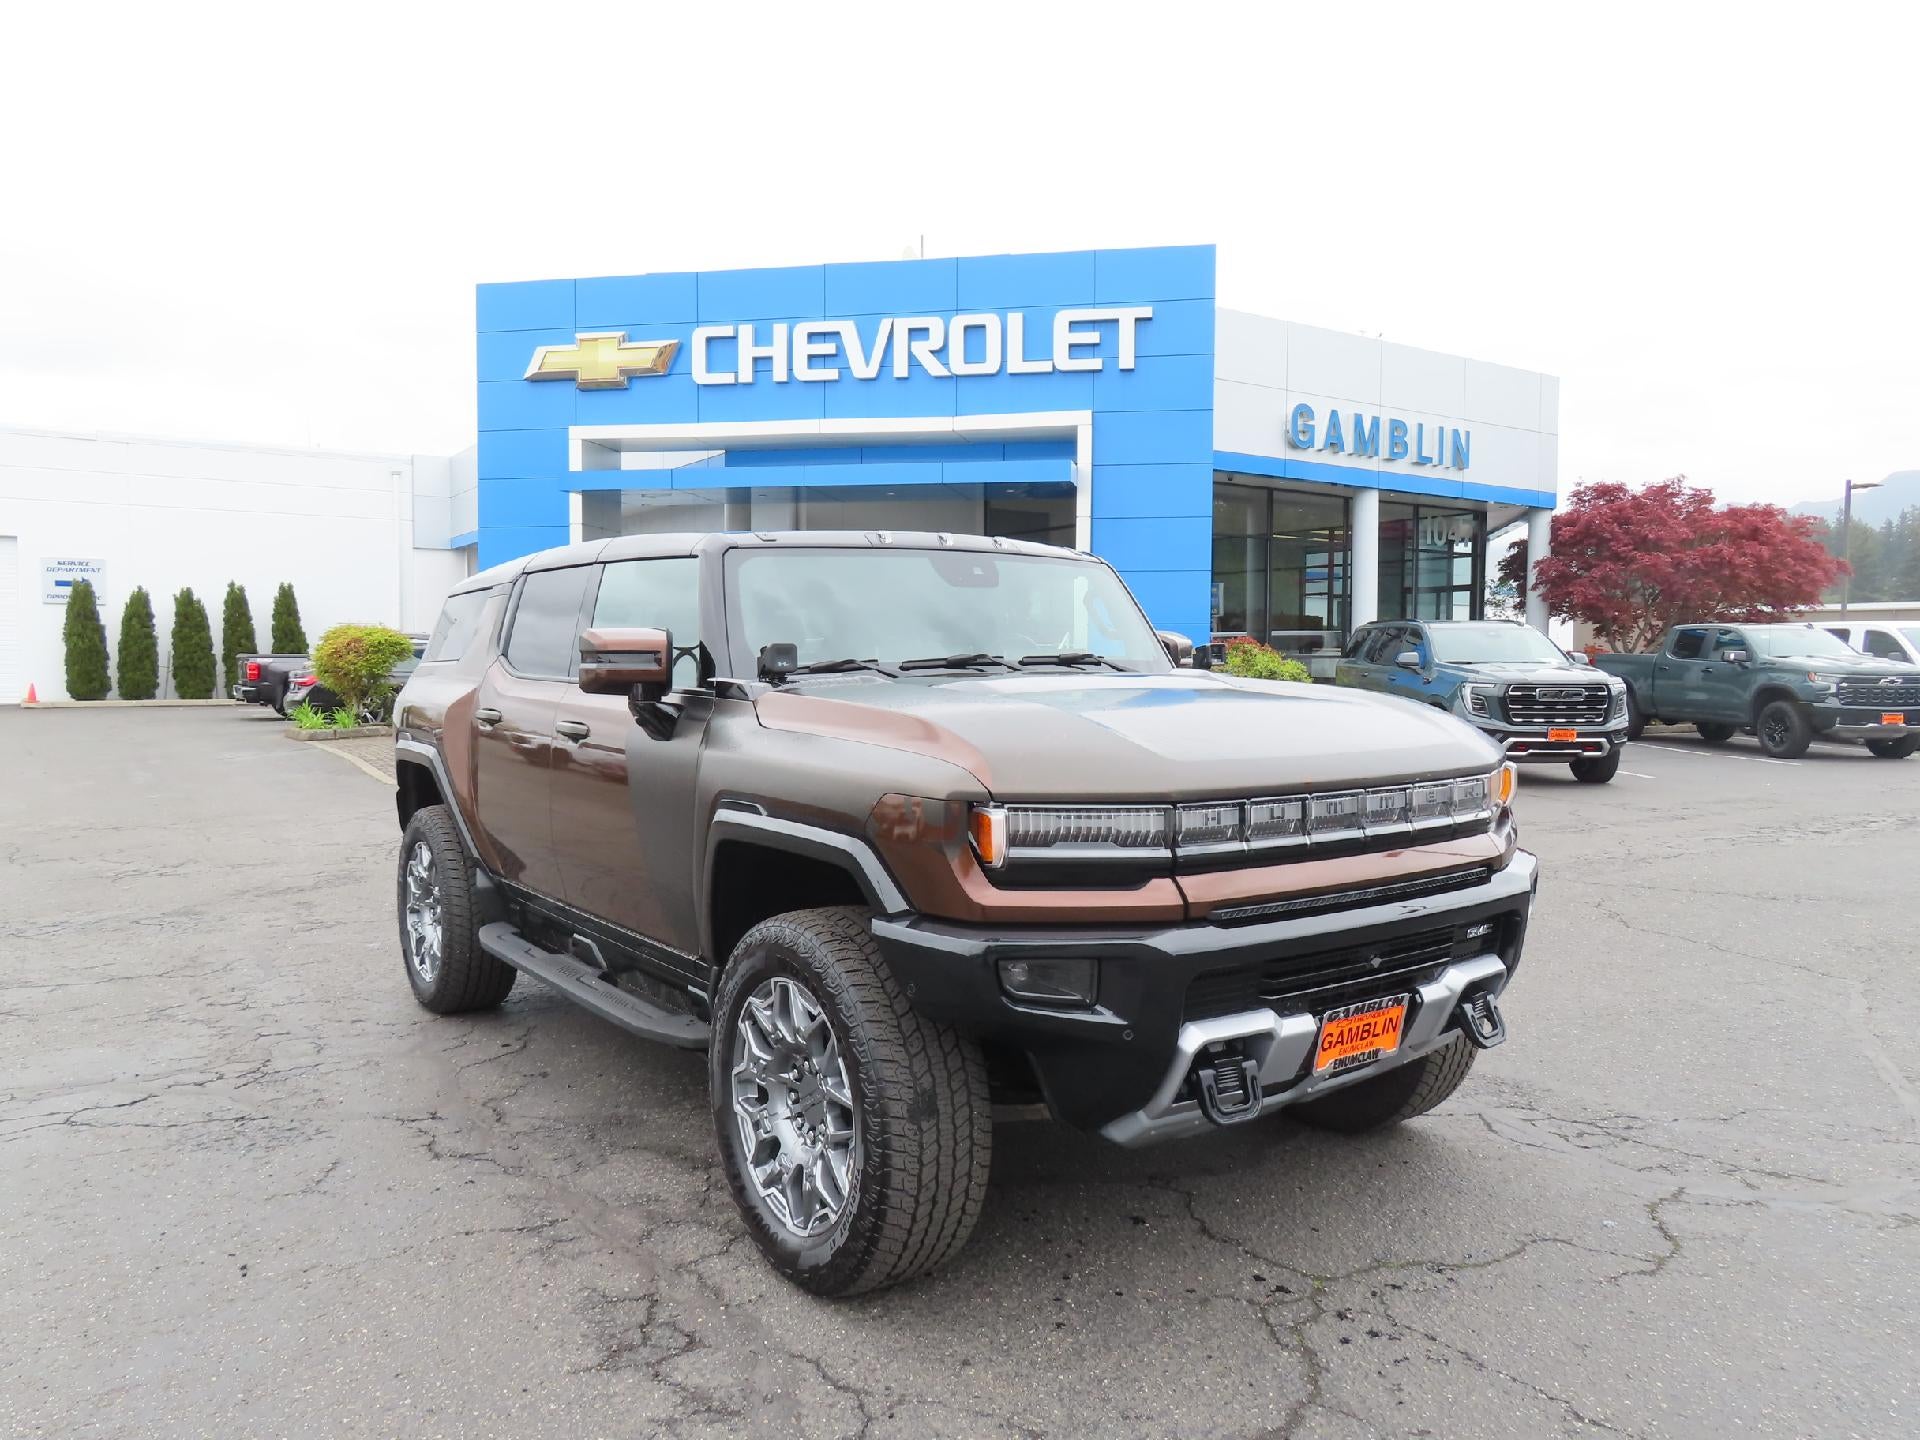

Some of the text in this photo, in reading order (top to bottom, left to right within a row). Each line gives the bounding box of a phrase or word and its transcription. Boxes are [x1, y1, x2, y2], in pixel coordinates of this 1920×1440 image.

[692, 306, 1153, 385] CHEVROLET
[1288, 403, 1470, 470] GAMBLIN
[1321, 1015, 1399, 1052] GAMBLIN
[1333, 1048, 1379, 1070] ENUMCLAW
